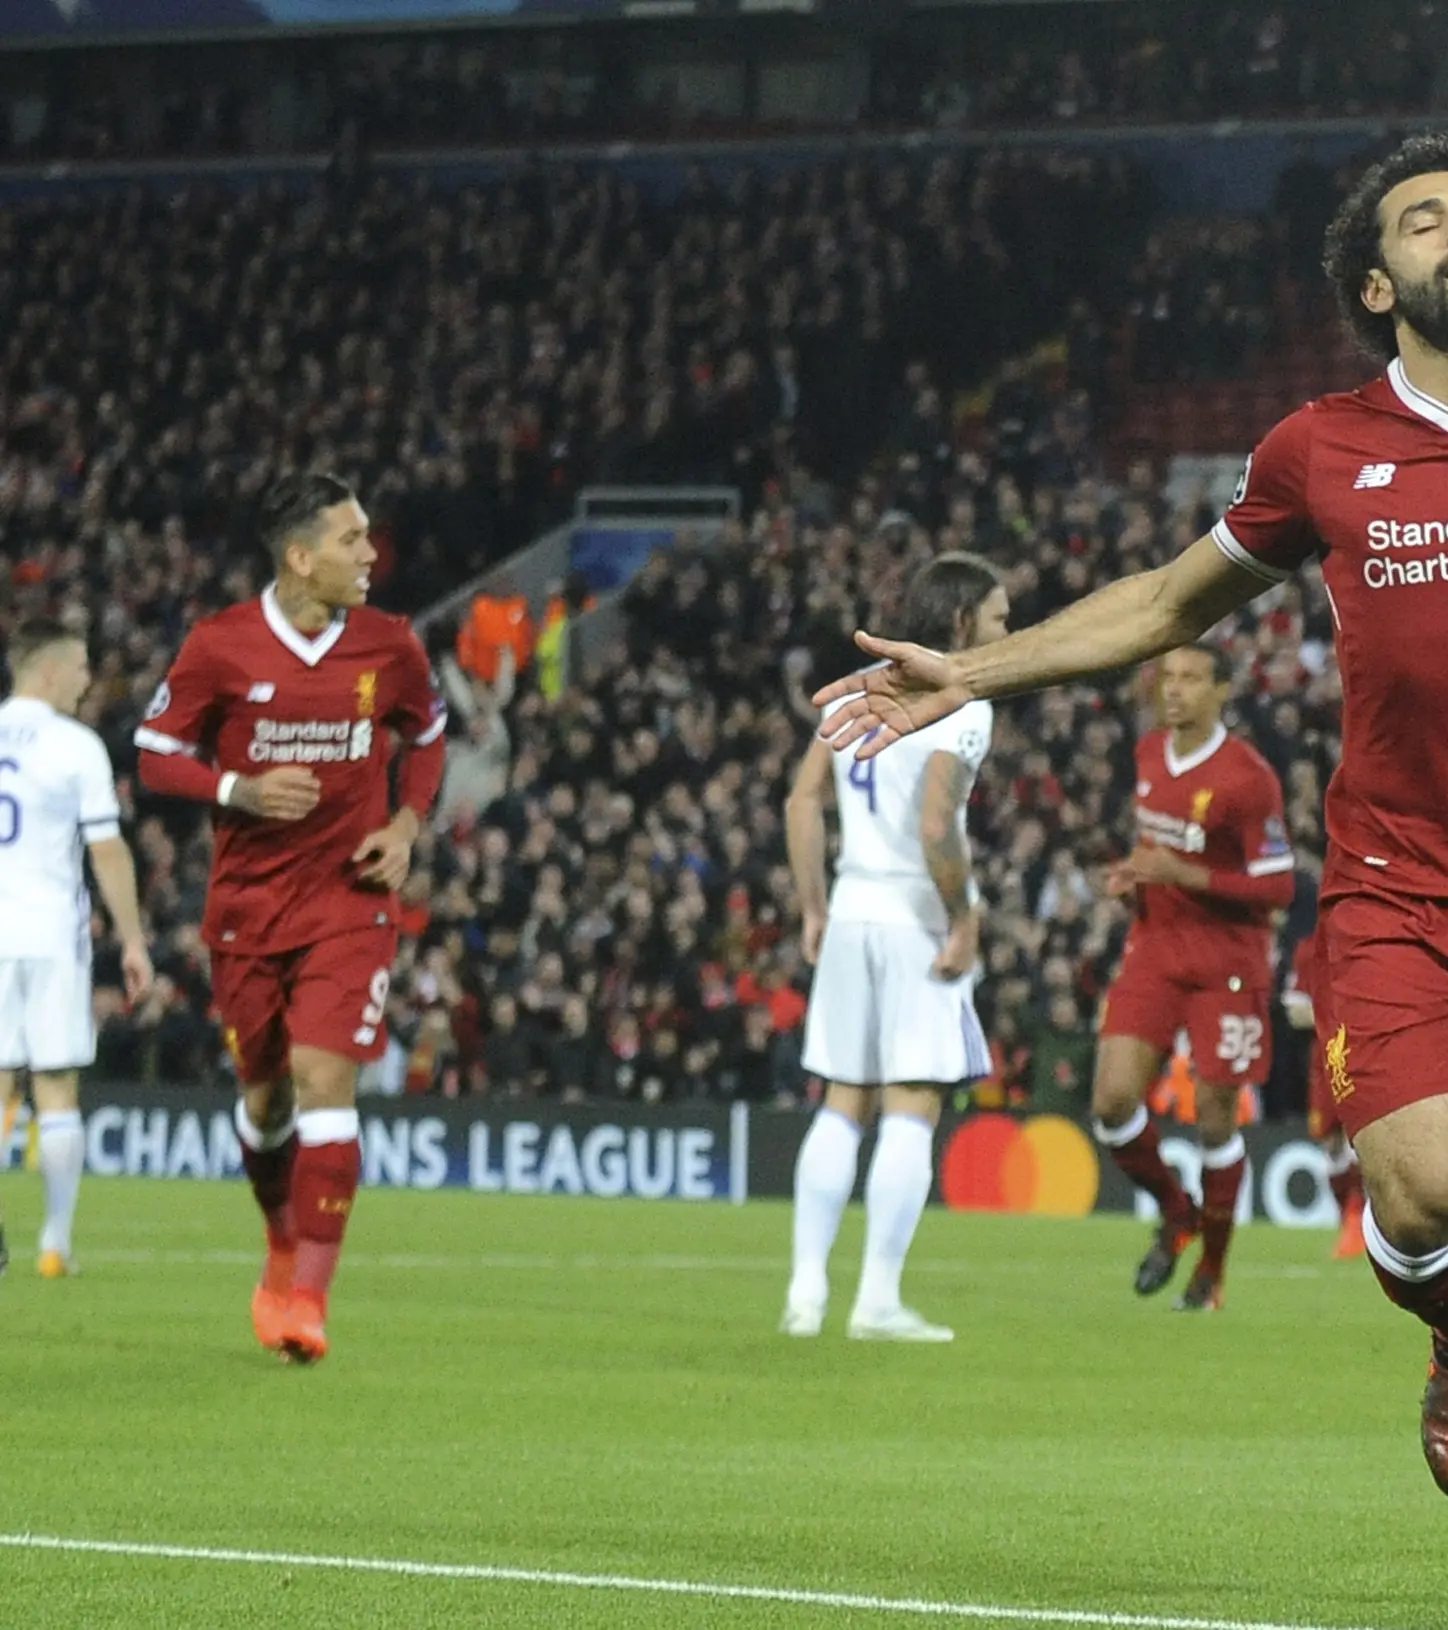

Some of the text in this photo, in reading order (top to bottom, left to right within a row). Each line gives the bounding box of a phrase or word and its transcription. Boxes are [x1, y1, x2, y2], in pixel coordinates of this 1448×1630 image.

[248, 740, 347, 762] Chartered
[255, 719, 350, 742] Standard
[364, 967, 391, 1025] 9
[1217, 1014, 1264, 1060] 32
[86, 1105, 448, 1190] CHAMNS
[467, 1119, 715, 1199] LEAGUE
